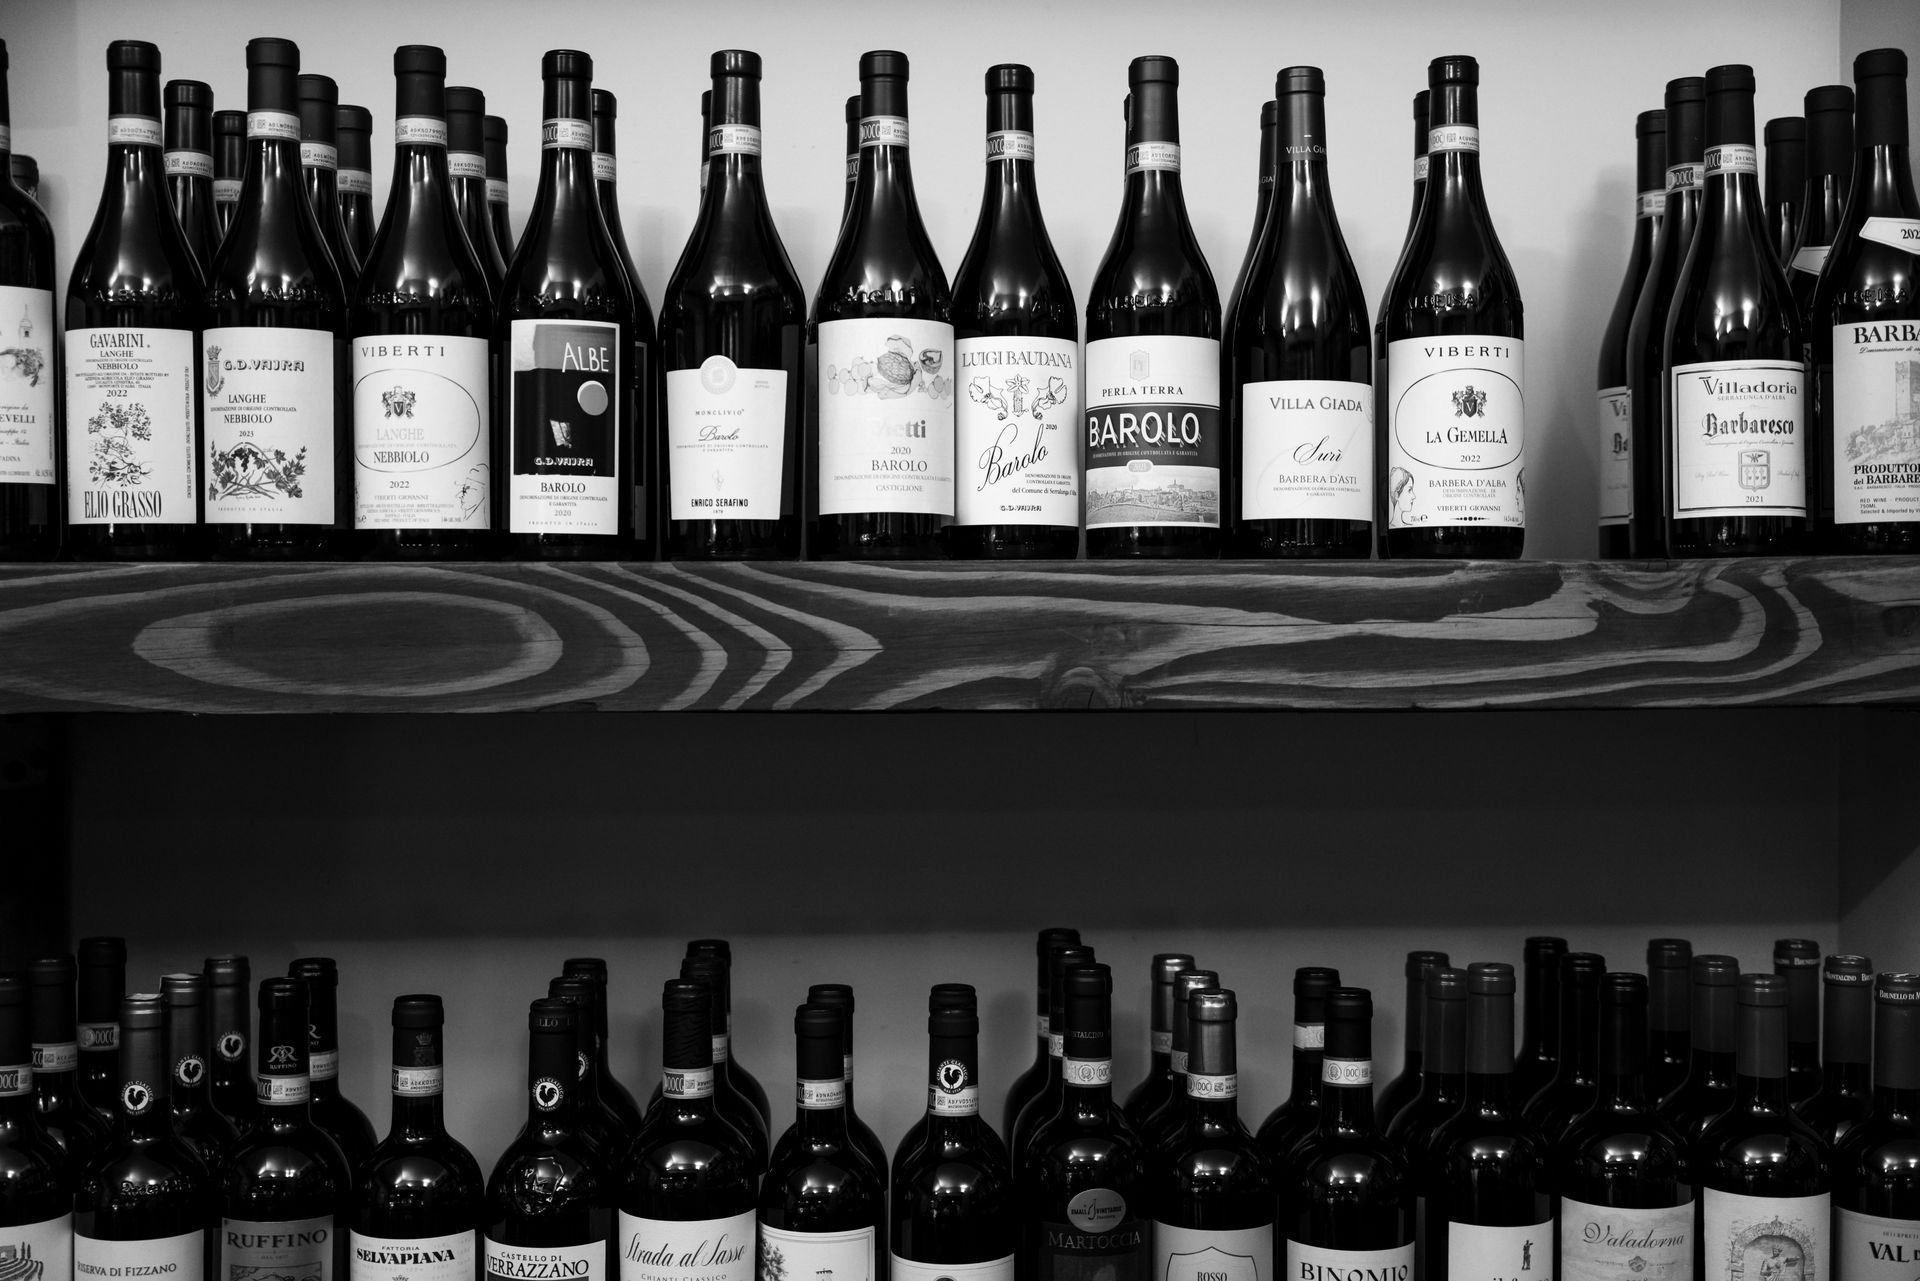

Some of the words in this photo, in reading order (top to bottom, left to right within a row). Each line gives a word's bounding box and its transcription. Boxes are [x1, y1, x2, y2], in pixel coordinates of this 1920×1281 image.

[1286, 145, 1312, 154] VILLA
[90, 333, 144, 348] GAVARINI
[362, 345, 445, 358] VIBERTI
[561, 342, 610, 373] ALBE
[1424, 346, 1510, 359] VIBERTI
[962, 351, 1003, 368] LUIGI
[1006, 351, 1072, 368] BAUDANA
[1102, 386, 1137, 398] PERLA
[1140, 385, 1184, 396] TERRA
[1699, 376, 1797, 396] Villadoria
[106, 389, 128, 398] 2022
[228, 394, 267, 403] LANGHE
[1269, 396, 1315, 411] VILLA
[1319, 396, 1363, 412] GIADA
[224, 414, 273, 424] NEBBIOLO
[1701, 411, 1795, 438] Barbaresco
[376, 429, 425, 441] LANGHE
[698, 424, 741, 442] Barolo
[1089, 411, 1201, 448] BAROLO
[1426, 431, 1442, 444] LA
[373, 451, 430, 463] NEBBIOLO
[890, 446, 912, 455] 2020
[977, 423, 1049, 491] Barolo
[1460, 455, 1481, 463] 2022
[871, 460, 928, 472] BAROLO
[389, 480, 410, 489] 2022
[1279, 474, 1327, 484] BARBERA
[1329, 473, 1357, 485] D'ASTI
[1429, 479, 1473, 488] BARBERA
[1476, 479, 1507, 488] D'ALBA
[1854, 478, 1864, 486] del
[541, 482, 586, 493] BAROLO
[84, 490, 109, 518] ELIO
[112, 490, 162, 518] GRASSO
[691, 499, 714, 508] ENRICO
[715, 499, 749, 508] SERAFINO
[1745, 495, 1764, 503] 2021
[1879, 989, 1908, 1001] BRUNELLO
[227, 1229, 328, 1249] RUFFINO
[1048, 1230, 1141, 1250] MARTOCCIA
[1582, 1221, 1685, 1249] Valadorna
[356, 1248, 456, 1265] SELVAPIANA
[501, 1251, 547, 1262] CASTELLO
[625, 1232, 675, 1267] Strada
[675, 1239, 708, 1268] al
[1868, 1241, 1911, 1263] VAL
[77, 1261, 107, 1277] RISERVA
[109, 1266, 122, 1276] DI
[125, 1262, 177, 1276] FIZZANO
[487, 1253, 590, 1279] VERRAZZANO
[1300, 1262, 1409, 1281] BINOMIO
[1197, 1271, 1228, 1281] ROSSO
